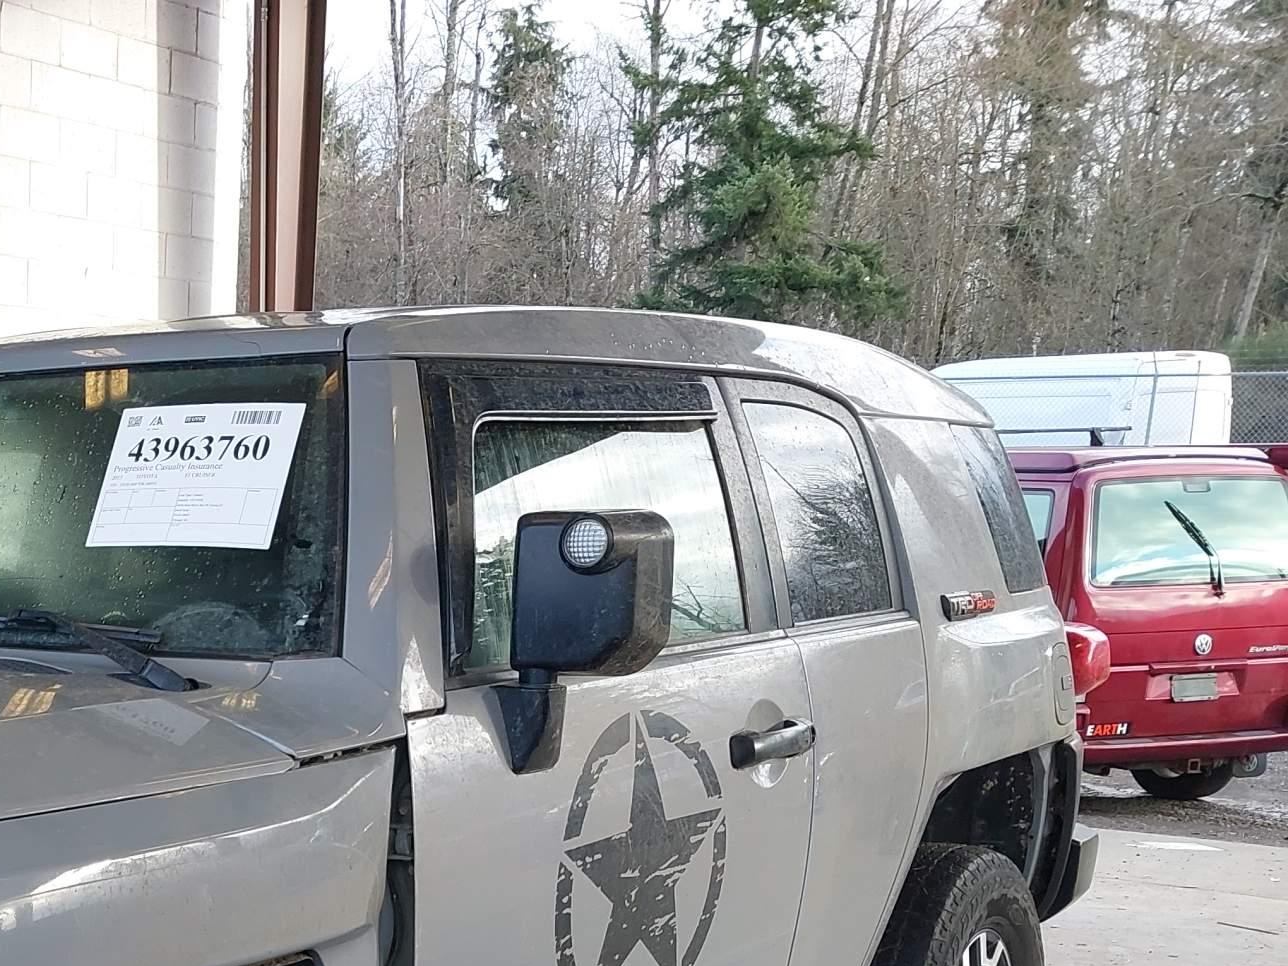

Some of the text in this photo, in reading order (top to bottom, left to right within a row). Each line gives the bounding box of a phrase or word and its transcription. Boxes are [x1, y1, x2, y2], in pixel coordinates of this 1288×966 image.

[127, 434, 271, 462] 43963760
[113, 462, 224, 475] Progressive Casualty Insurance
[951, 596, 974, 616] TRD
[976, 598, 996, 610] ROAD
[1086, 722, 1128, 737] EARTH
